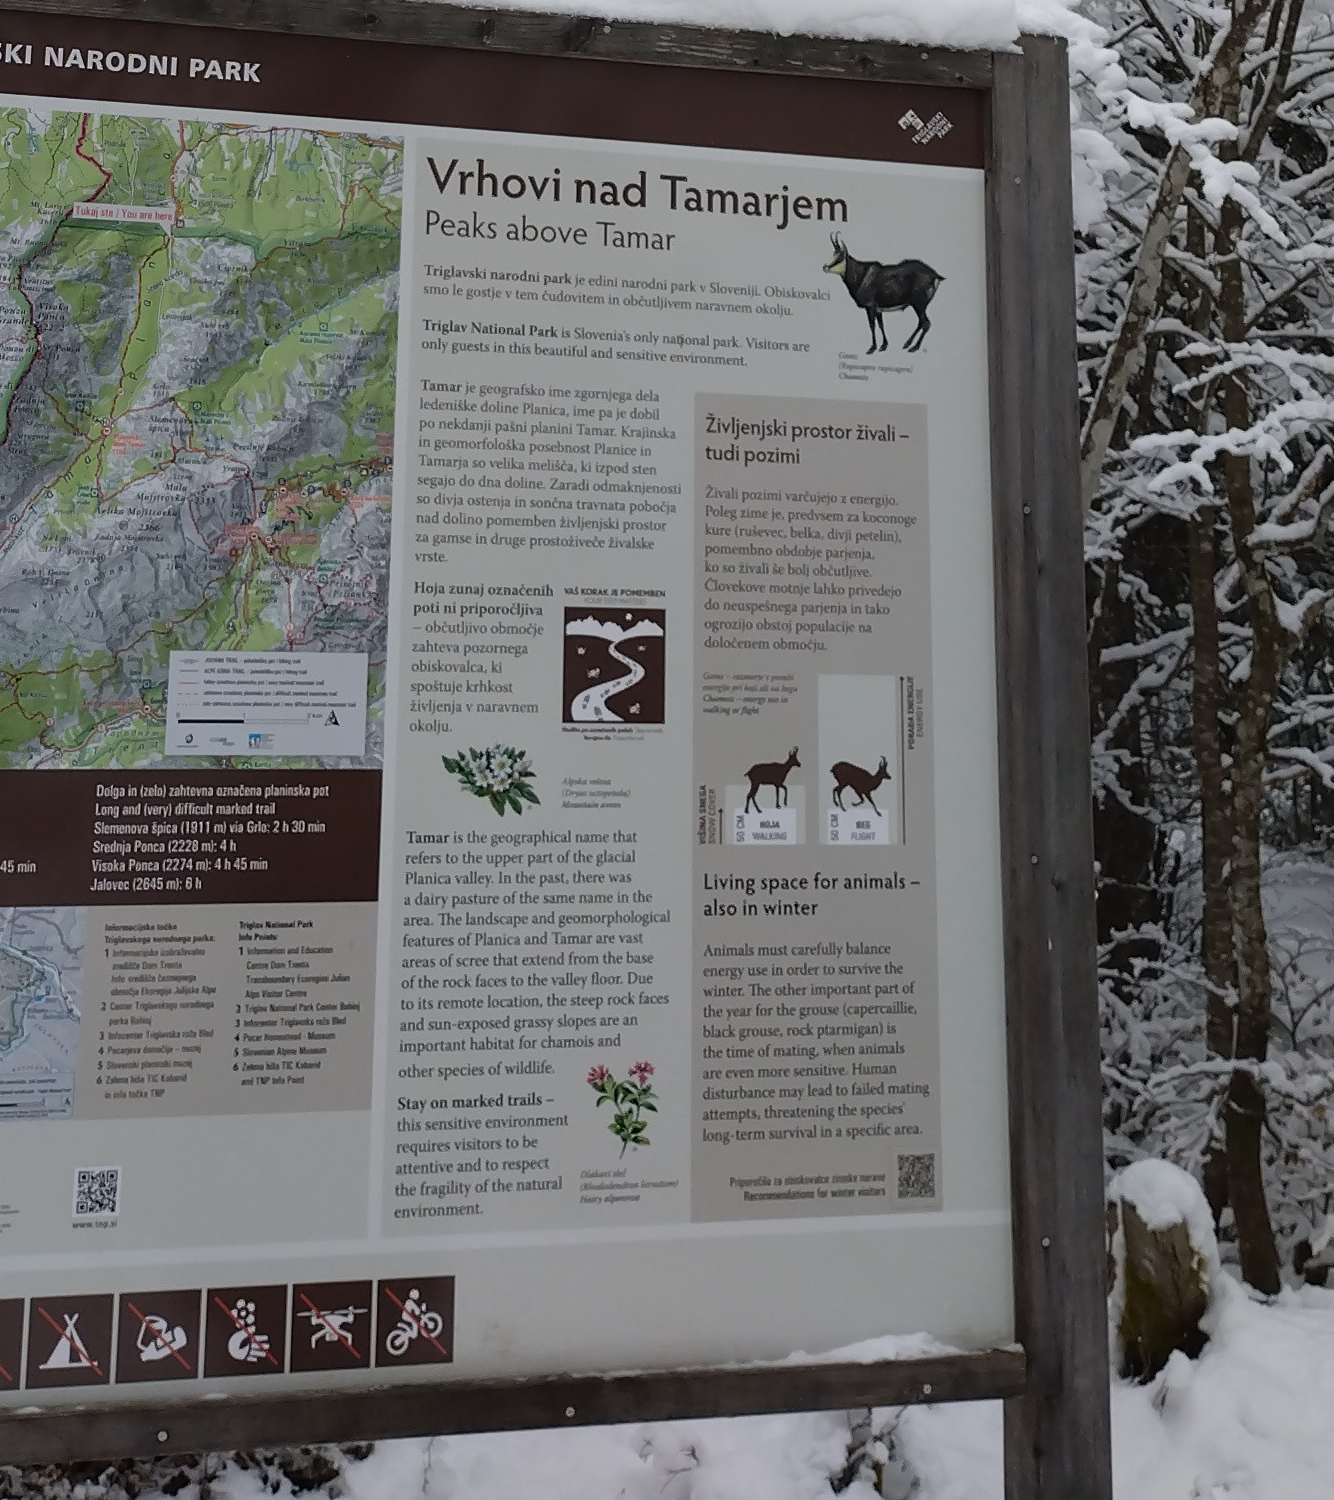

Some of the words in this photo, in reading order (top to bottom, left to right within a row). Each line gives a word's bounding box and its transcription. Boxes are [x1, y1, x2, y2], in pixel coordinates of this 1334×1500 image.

[44, 47, 177, 75] NARODNI
[189, 58, 260, 82] PARK
[428, 158, 560, 201] Vrhovi
[574, 170, 647, 207] nad
[660, 175, 848, 228] Tamarjem
[75, 205, 98, 219] Tukaj
[101, 206, 114, 217] ste
[122, 207, 138, 220] You
[139, 212, 153, 220] are
[155, 211, 173, 221] here
[425, 209, 497, 239] Peaks
[506, 215, 587, 245] above
[596, 221, 676, 251] Tamar
[423, 264, 487, 280] Triglavski
[489, 270, 540, 282] narodni
[543, 272, 572, 286] park
[574, 274, 585, 288] je
[588, 274, 617, 287] edini
[621, 278, 667, 290] narodni
[670, 280, 696, 294] park
[699, 284, 706, 292] v
[709, 282, 761, 297] Sloveniji.
[764, 286, 830, 300] Obiskovalci
[422, 318, 467, 335] Triglav
[470, 321, 525, 336] National
[529, 324, 558, 338] Park
[561, 327, 571, 338] is
[573, 327, 631, 341] Slovenia's
[633, 331, 659, 345] only
[662, 334, 709, 347] national
[712, 336, 742, 350] park.
[745, 337, 789, 350] Visitors
[791, 343, 810, 352] are
[421, 337, 448, 354] only
[451, 342, 490, 354] guests
[493, 341, 505, 353] in
[508, 341, 531, 354] this
[534, 343, 587, 357] beautiful
[590, 346, 613, 359] and
[615, 350, 667, 361] sensitive
[669, 354, 747, 366] environment.
[705, 414, 787, 440] Življenjski
[791, 425, 852, 442] prostor
[855, 424, 895, 442] živali
[705, 443, 739, 461] tudi
[744, 447, 800, 467] pozimi
[414, 581, 445, 597] Hoja
[448, 583, 484, 597] zunaj
[487, 584, 553, 596] označenih
[413, 601, 439, 616] poti
[443, 601, 456, 614] ni
[459, 602, 543, 618] priporočljiva
[96, 784, 125, 799] Dolga
[127, 784, 137, 797] in
[139, 784, 166, 798] (zelo)
[168, 784, 213, 796] zahtevna
[215, 784, 262, 796] označena
[264, 783, 311, 798] planinska
[312, 785, 329, 798] pot
[95, 802, 119, 818] Long
[121, 802, 141, 815] and
[143, 803, 172, 818] (very)
[174, 802, 213, 815] difficult
[215, 802, 253, 814] marked
[255, 802, 275, 814] trail
[405, 830, 450, 844] Tamar
[453, 830, 463, 844] is
[467, 830, 487, 843] the
[490, 829, 571, 847] geographical
[575, 833, 609, 843] name
[612, 829, 637, 843] that
[0, 859, 15, 873] 45
[17, 860, 36, 873] min
[703, 873, 755, 895] Living
[760, 877, 808, 895] space
[813, 871, 838, 889] for
[843, 871, 905, 889] animals
[703, 898, 737, 916] also
[742, 899, 757, 916] in
[763, 899, 818, 916] winter
[703, 943, 755, 957] Animals
[757, 945, 788, 956] must
[791, 942, 843, 958] carefully
[845, 941, 891, 955] balance
[397, 1096, 427, 1113] Stay
[429, 1099, 448, 1109] on
[451, 1093, 503, 1108] marked
[507, 1092, 542, 1106] trails
